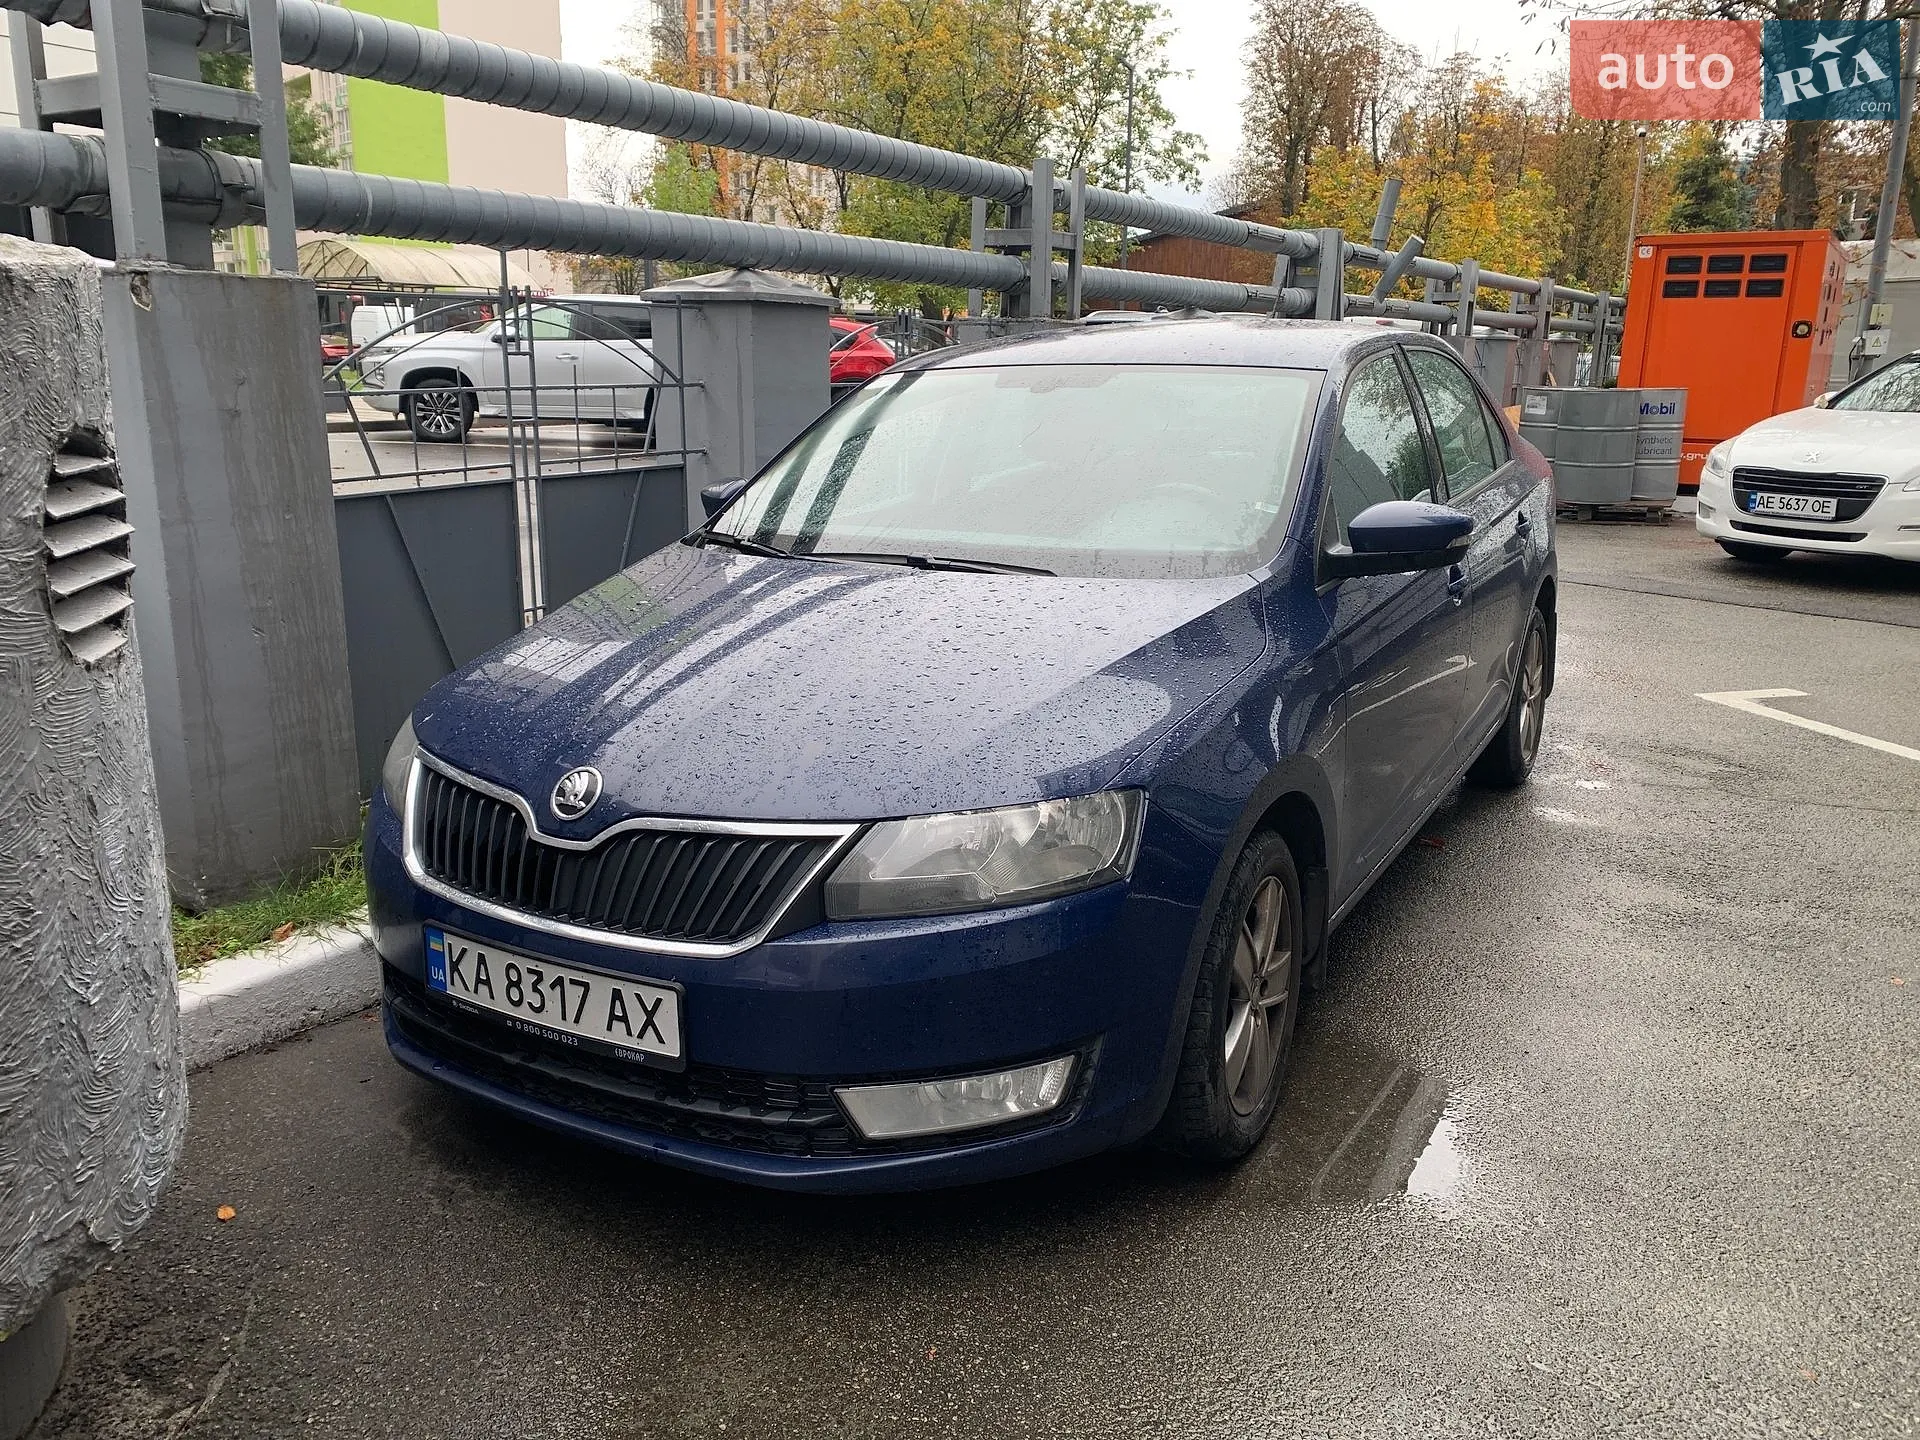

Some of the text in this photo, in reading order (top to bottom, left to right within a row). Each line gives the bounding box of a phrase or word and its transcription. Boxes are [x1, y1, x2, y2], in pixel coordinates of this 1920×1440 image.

[1639, 402, 1676, 415] Mobil
[1638, 446, 1673, 455] ubricant
[1757, 495, 1832, 514] AE 5637 OE
[431, 964, 446, 983] UA
[447, 941, 667, 1045] KA 8317 AX
[515, 1021, 579, 1046] 0 800 500 023
